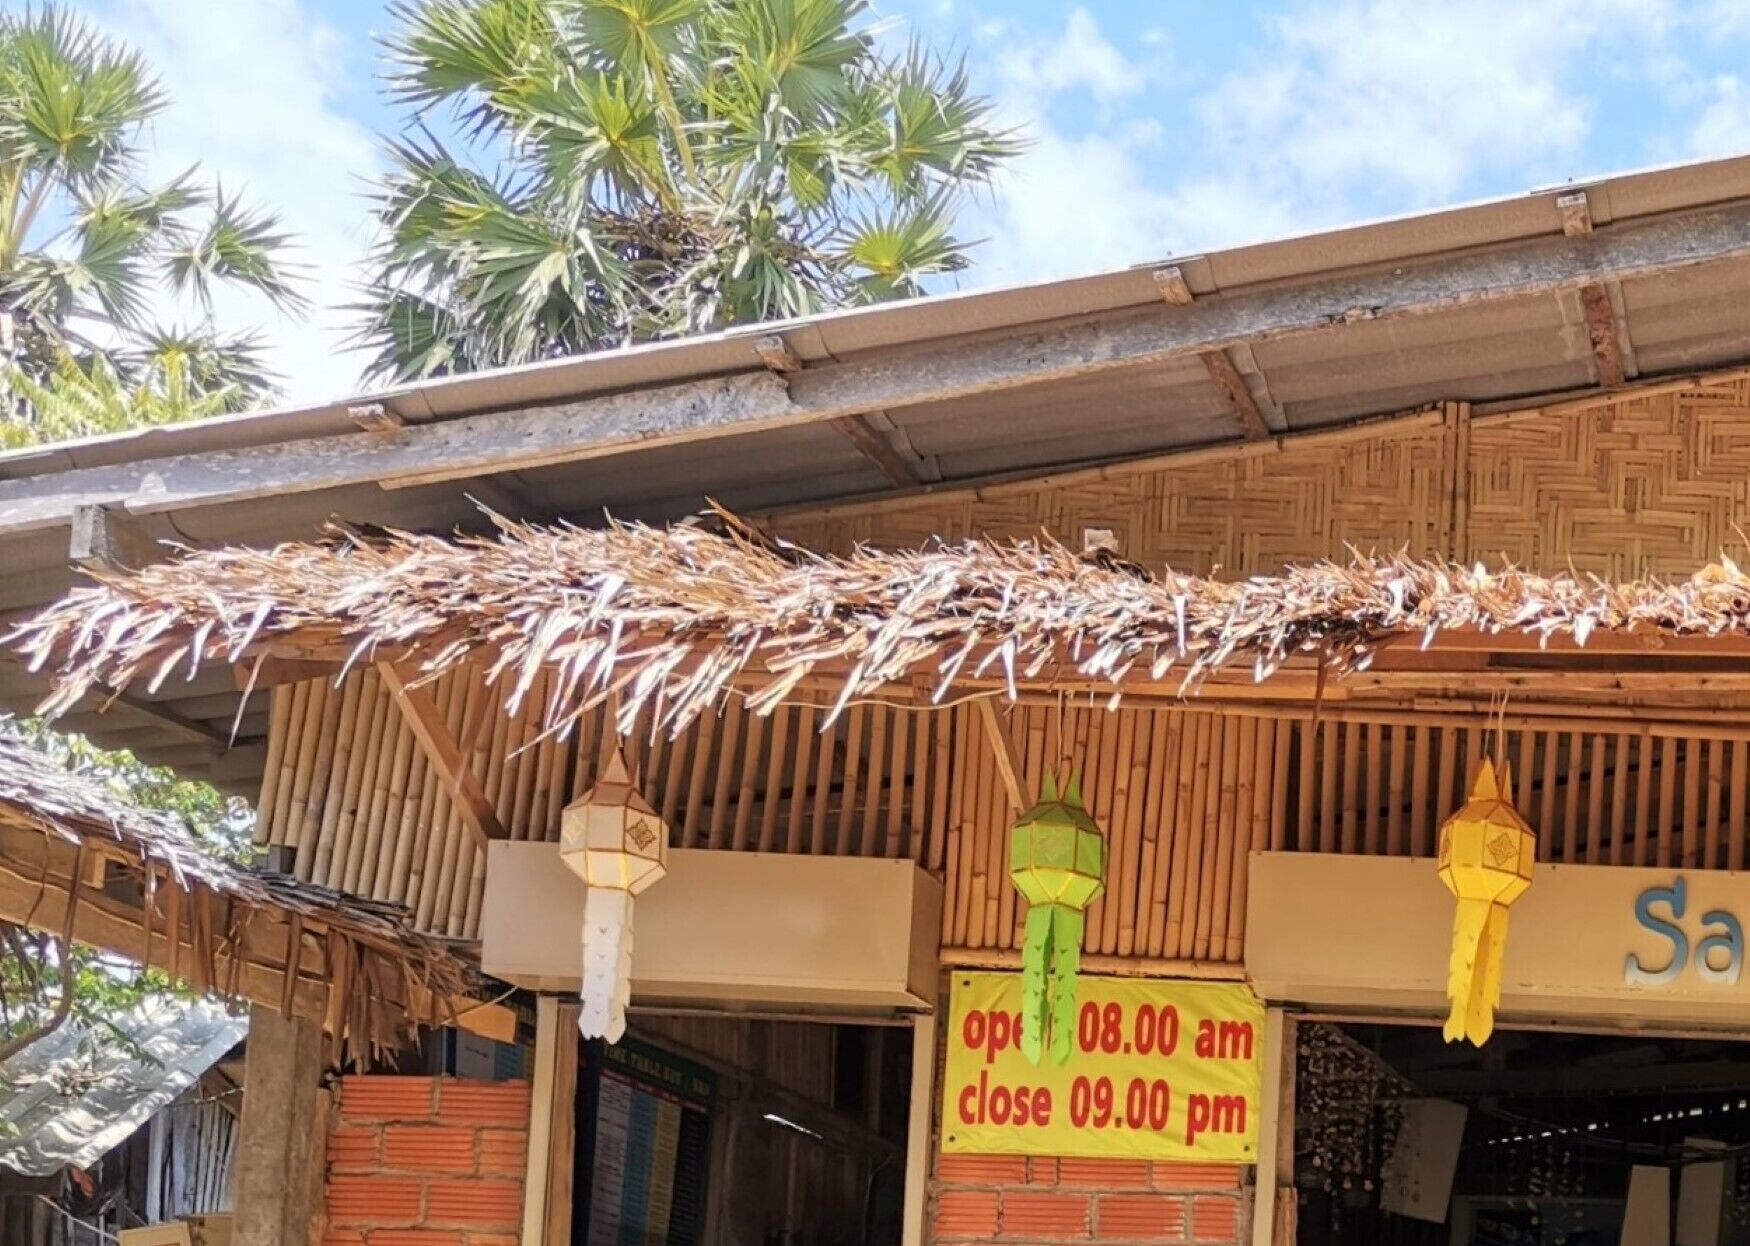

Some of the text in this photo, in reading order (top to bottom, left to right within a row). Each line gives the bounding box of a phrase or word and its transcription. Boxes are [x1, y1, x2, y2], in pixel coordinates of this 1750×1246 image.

[1078, 1001, 1179, 1056] 08.00
[1195, 1018, 1254, 1059] am
[959, 1070, 1247, 1146] close 09.00 pm
